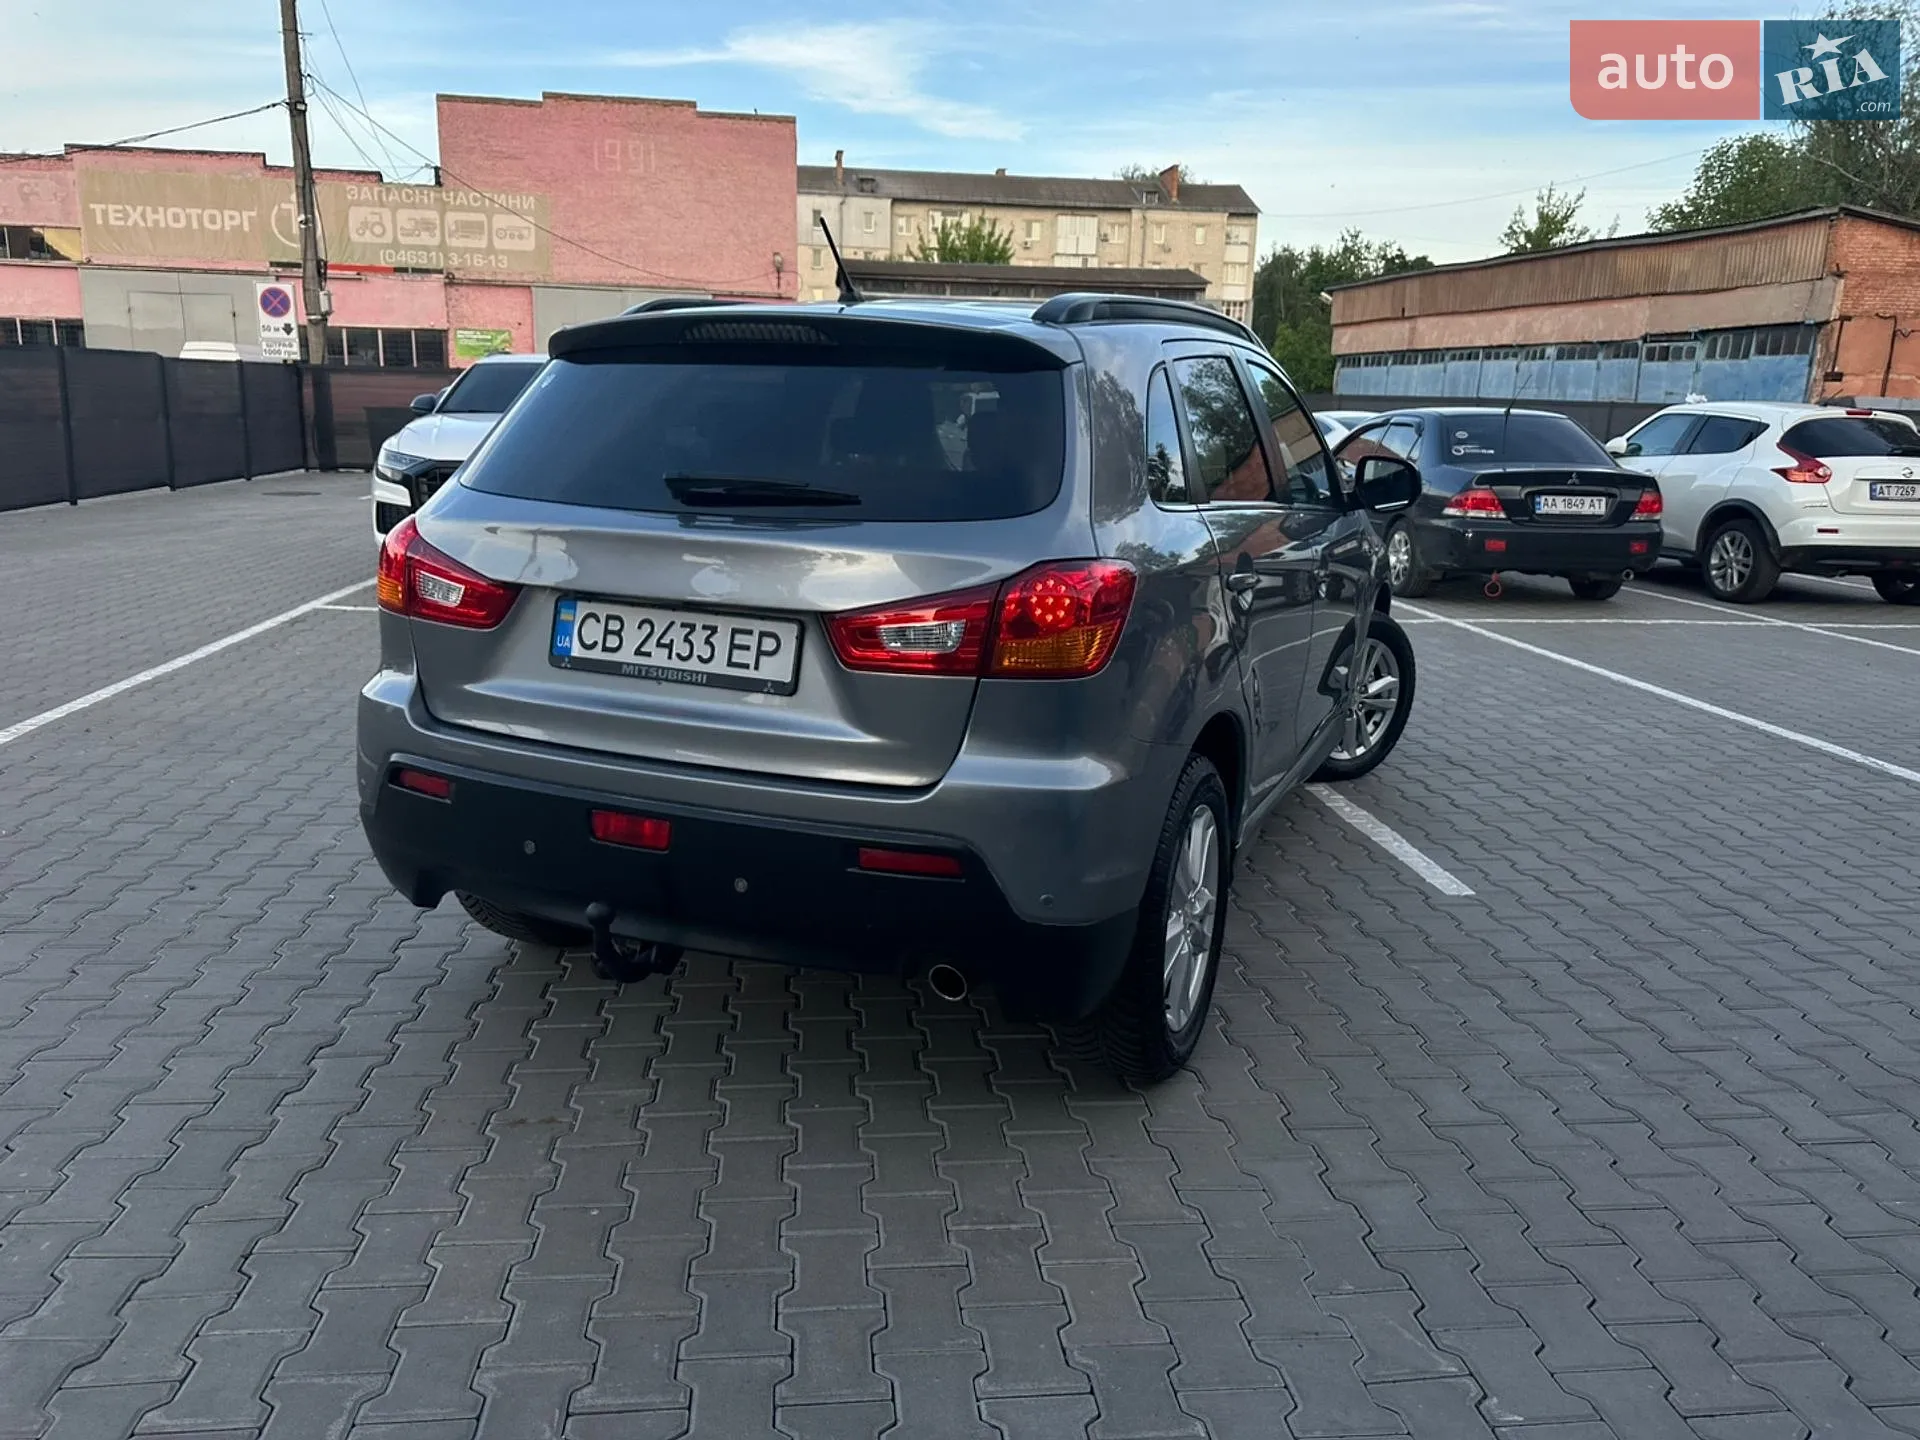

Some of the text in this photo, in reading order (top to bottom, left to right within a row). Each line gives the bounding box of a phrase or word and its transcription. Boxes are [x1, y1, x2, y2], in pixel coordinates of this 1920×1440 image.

[346, 185, 536, 211] ЗАПАСНІ ЧАСТИНИ
[89, 203, 258, 232] ТЕХНОТОРГ
[379, 249, 509, 269] (04631) 3-16-13
[1878, 485, 1916, 496] AT 7269
[1543, 497, 1604, 510] AA 1849 AT
[557, 635, 571, 648] UA
[577, 612, 782, 671] CB 2433 EP
[621, 663, 708, 684] MITSUBISHI
